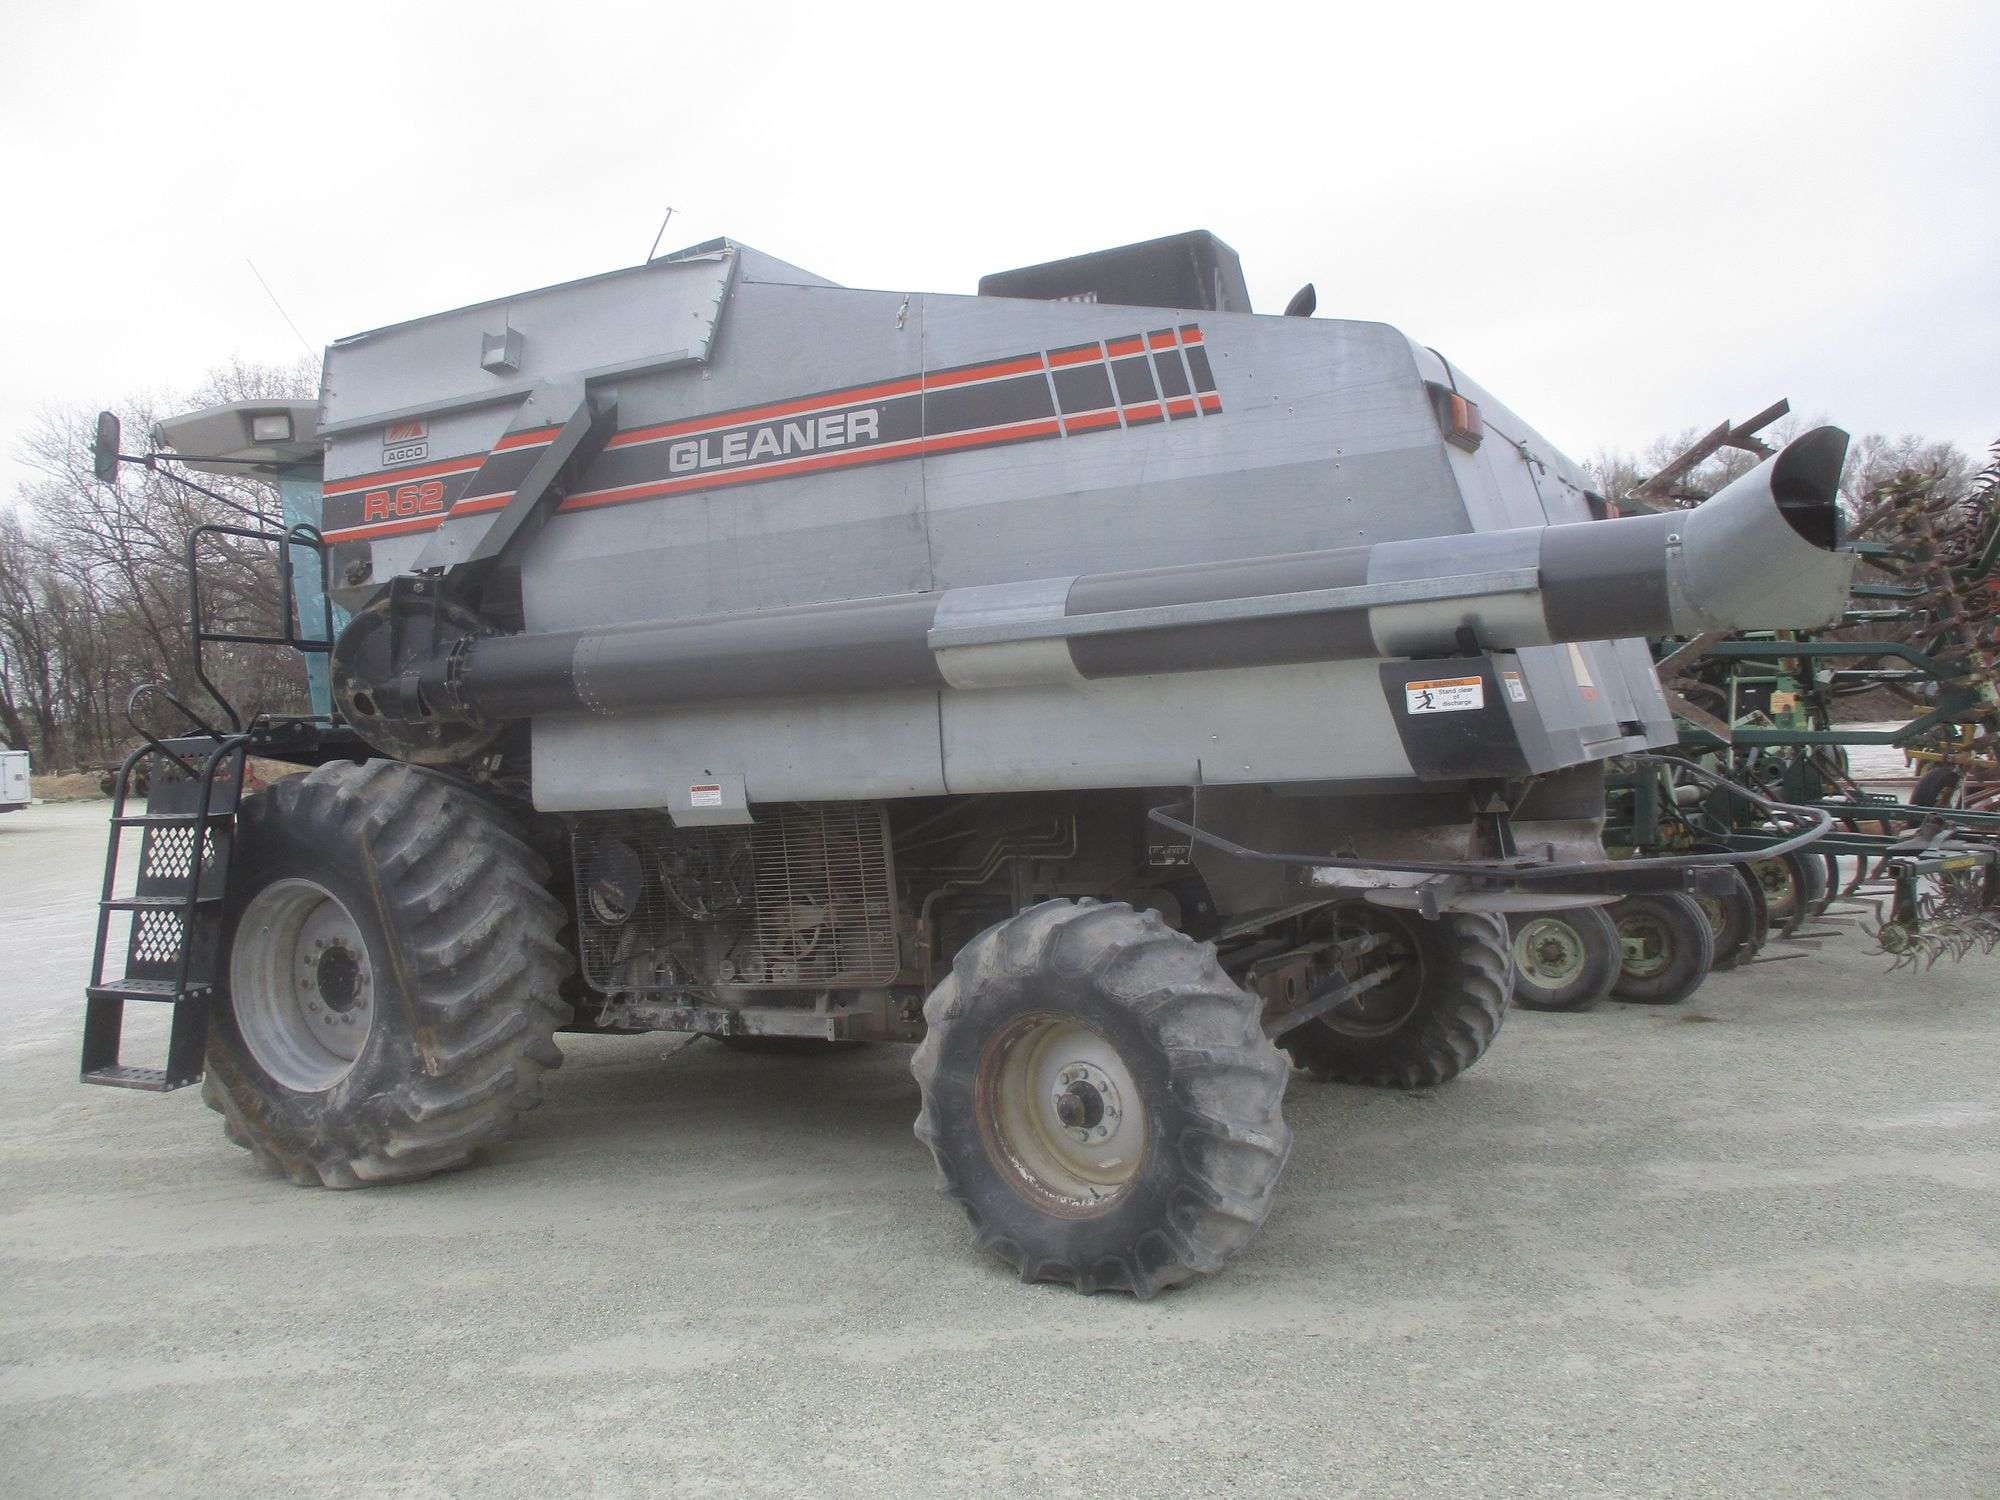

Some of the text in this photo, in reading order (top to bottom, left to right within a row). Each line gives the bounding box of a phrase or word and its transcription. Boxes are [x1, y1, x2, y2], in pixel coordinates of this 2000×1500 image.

[387, 447, 423, 462] AGCO
[669, 408, 879, 472] GLEANER
[364, 481, 444, 522] R-62
